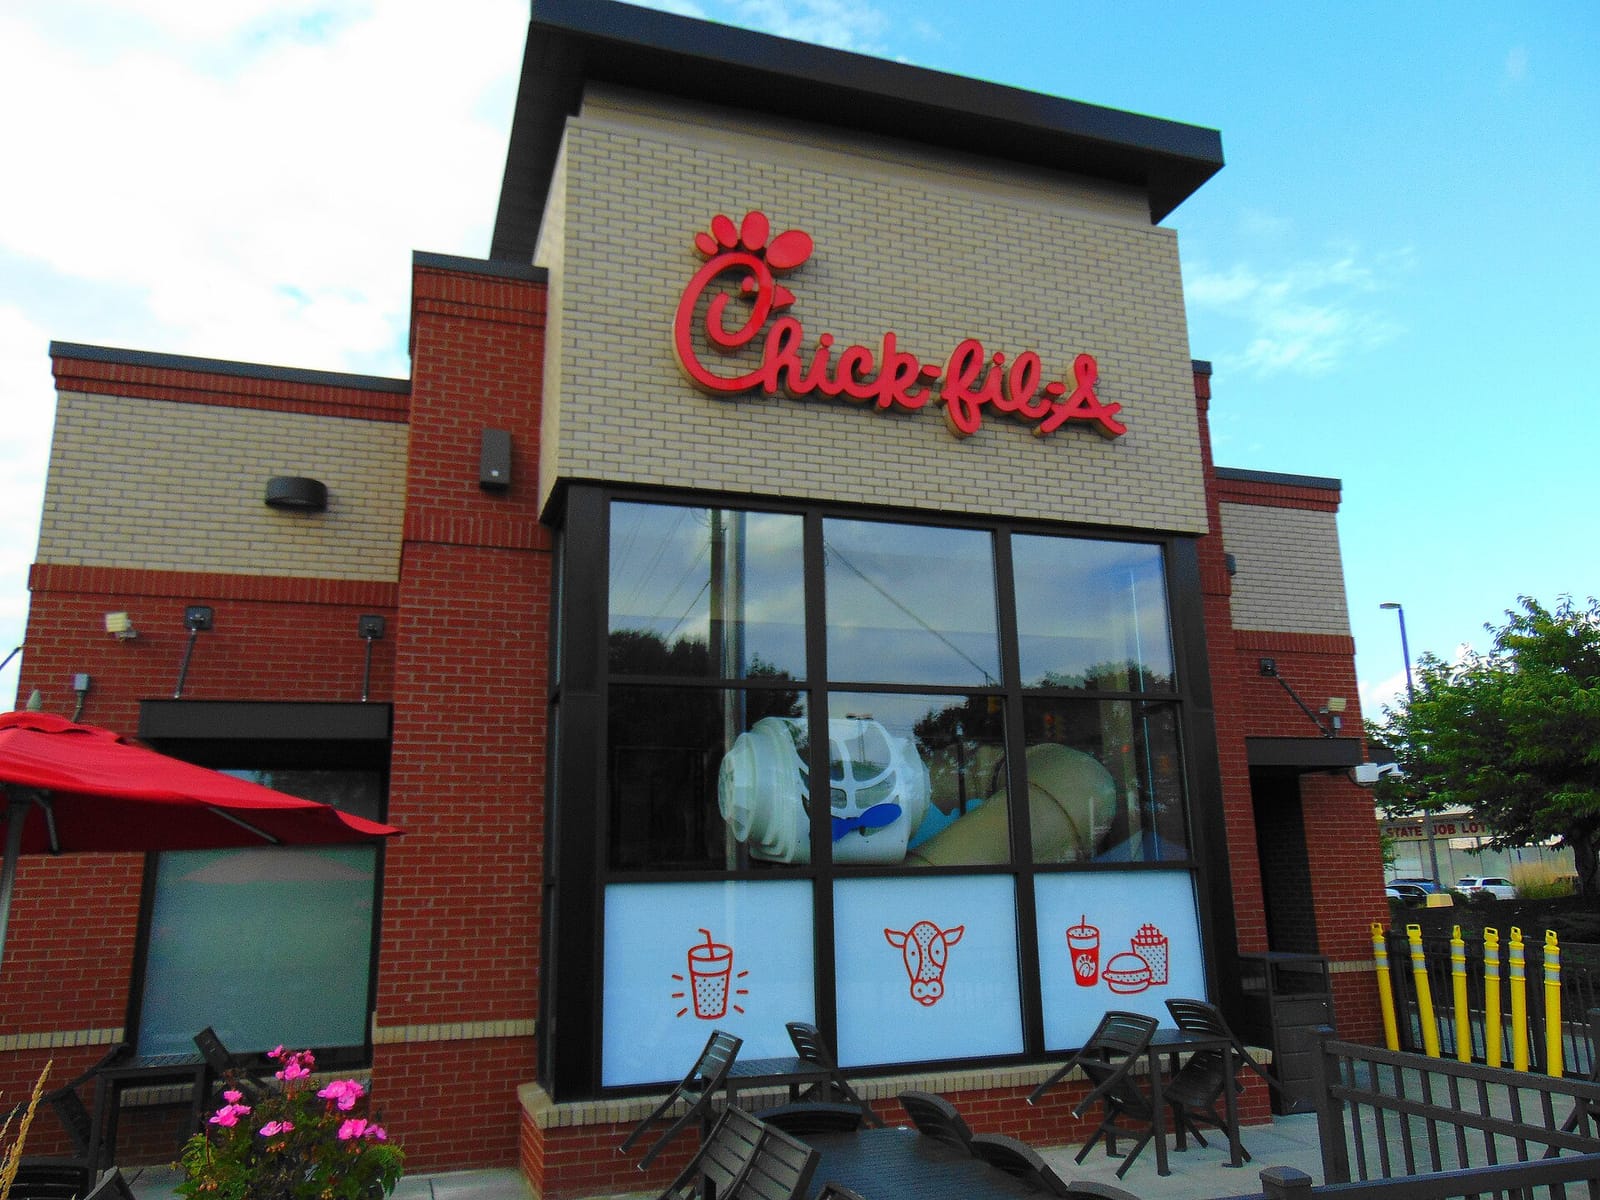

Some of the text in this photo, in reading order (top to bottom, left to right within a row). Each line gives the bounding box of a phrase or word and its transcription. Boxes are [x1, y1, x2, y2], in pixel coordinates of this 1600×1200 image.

[673, 211, 1127, 439] Chick-fil-A
[1386, 826, 1423, 837] STATE
[1432, 823, 1456, 836] JOB
